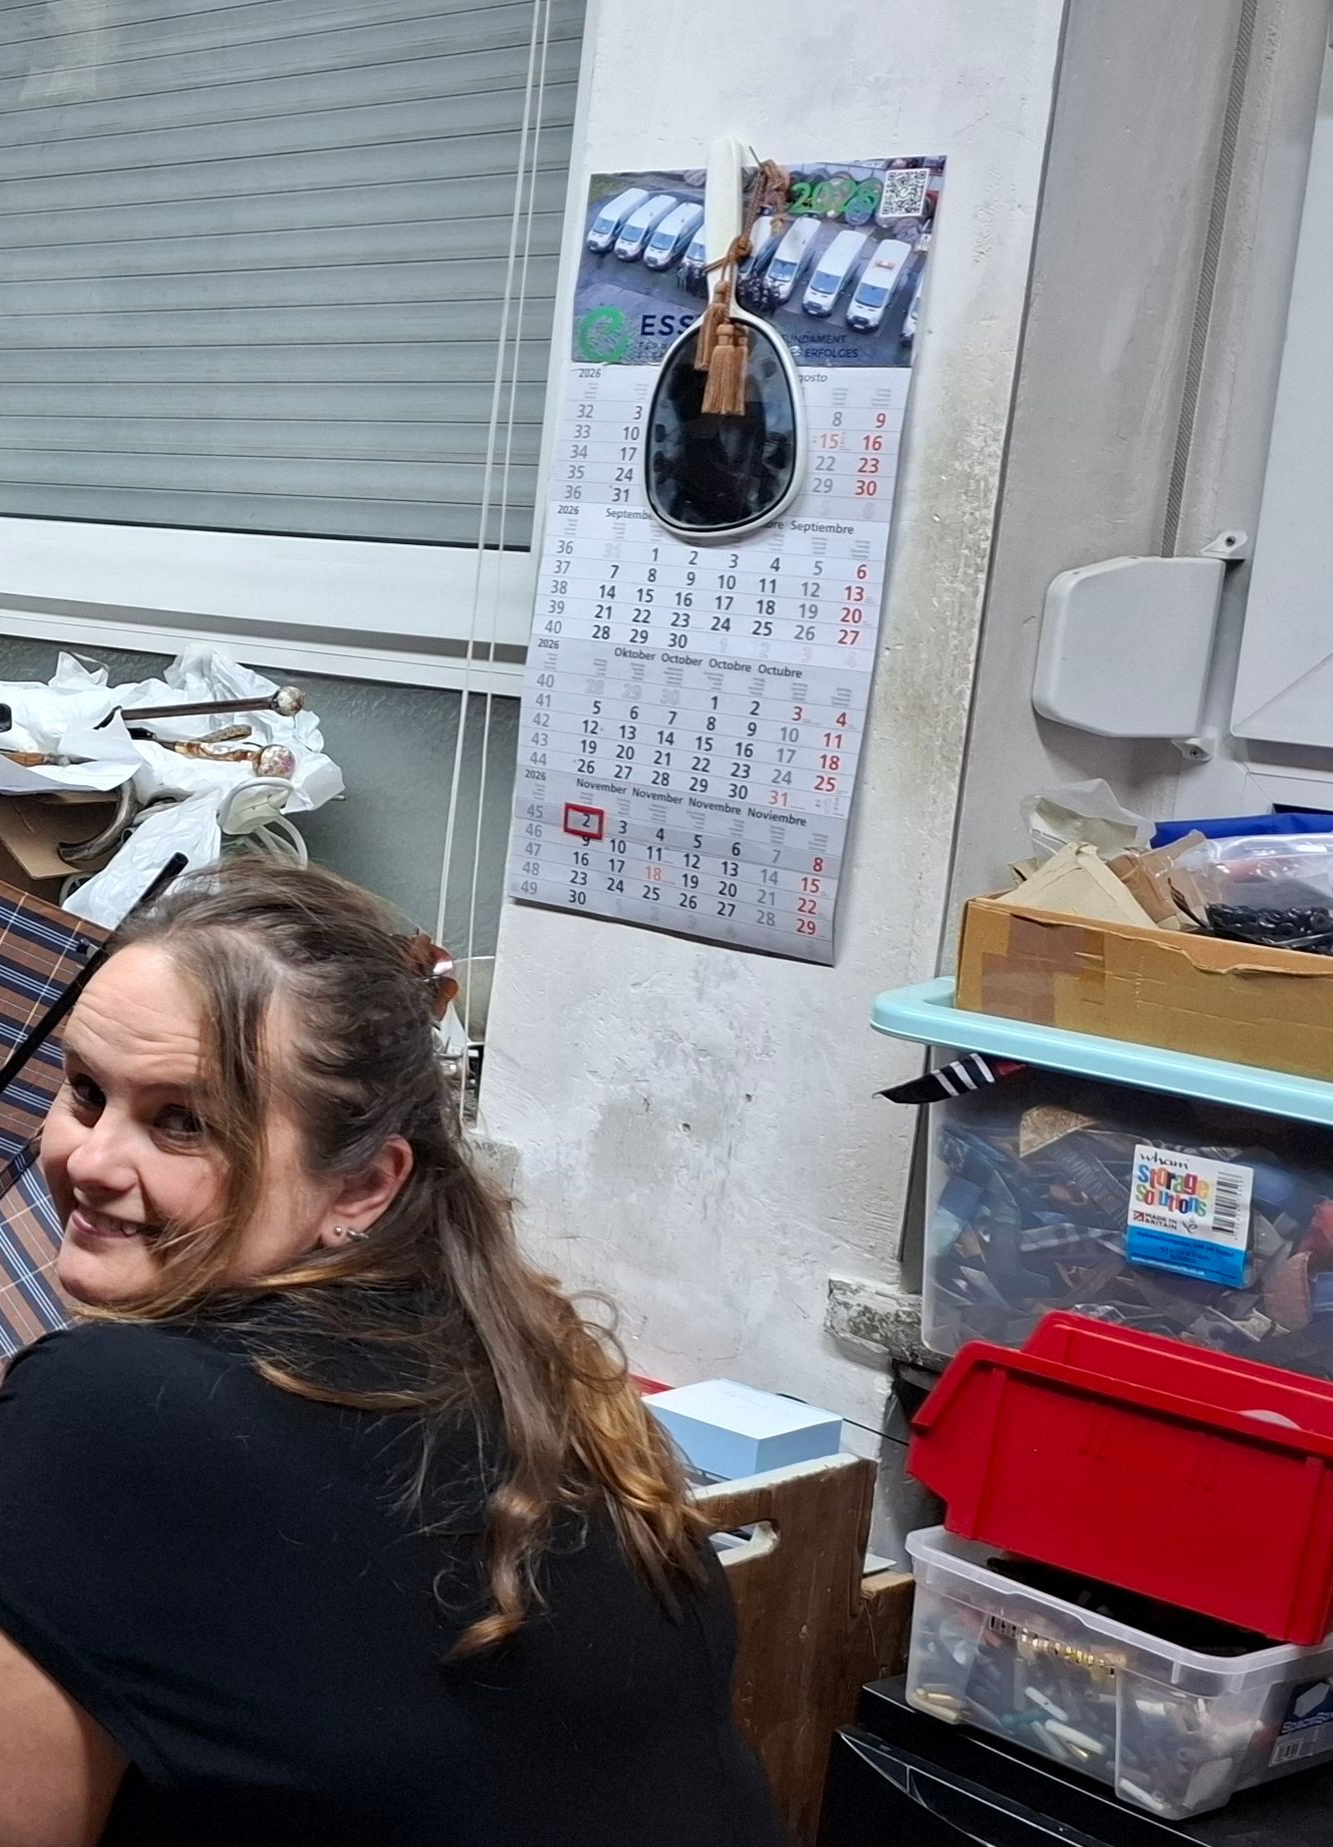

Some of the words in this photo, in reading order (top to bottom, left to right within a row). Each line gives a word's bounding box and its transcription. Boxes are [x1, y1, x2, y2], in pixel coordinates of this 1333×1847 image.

[805, 348, 859, 359] ERFOLGES
[579, 368, 601, 378] 2026
[799, 374, 827, 384] gosto
[577, 405, 593, 418] 32
[634, 406, 642, 419] 3
[833, 412, 842, 426] 8
[876, 413, 886, 428] 9
[574, 425, 590, 438] 33
[623, 427, 639, 440] 10
[820, 434, 839, 448] 15
[863, 435, 882, 450] 16
[570, 445, 587, 458] 34
[621, 448, 637, 461] 17
[815, 456, 835, 471] 22
[858, 458, 880, 473] 23
[565, 486, 581, 499] 36
[613, 488, 629, 502] 31
[567, 465, 585, 479] 35
[615, 468, 633, 482] 24
[812, 478, 833, 493] 29
[855, 481, 877, 495] 30
[557, 505, 579, 514] 2026
[606, 508, 654, 520] Septembe
[791, 521, 854, 534] Septiembre
[652, 548, 659, 561] 1
[689, 551, 698, 564] 2
[729, 554, 739, 568] 3
[770, 558, 780, 572] 4
[813, 561, 823, 575] 5
[857, 565, 867, 579] 6
[611, 565, 619, 578] 7
[648, 568, 657, 582] 8
[686, 572, 695, 585] 9
[718, 575, 736, 589] 10
[759, 579, 776, 593] 11
[801, 582, 820, 597] 12
[844, 586, 864, 601] 13
[599, 585, 615, 599] 14
[637, 588, 654, 602] 15
[675, 592, 692, 607] 16
[715, 596, 734, 610] 17
[757, 600, 775, 615] 18
[799, 604, 818, 619] 19
[841, 608, 862, 623] 20
[592, 625, 610, 639] 28
[629, 629, 648, 644] 29
[668, 633, 687, 648] 30
[595, 605, 612, 619] 21
[632, 609, 651, 623] 22
[671, 612, 690, 628] 23
[711, 617, 731, 632] 24
[752, 621, 773, 636] 25
[794, 625, 815, 641] 26
[838, 630, 859, 645] 27
[538, 639, 559, 649] 2026
[615, 648, 655, 661] Oktober
[661, 652, 702, 666] October
[709, 658, 752, 672] Octobre
[758, 664, 803, 678] Octubre
[593, 701, 601, 714] 5
[630, 706, 639, 719] 6
[668, 711, 677, 725] 7
[706, 717, 716, 731] 8
[747, 722, 757, 736] 9
[781, 727, 799, 742] 10
[824, 733, 842, 748] 11
[711, 696, 718, 710] 1
[750, 701, 760, 715] 2
[792, 706, 803, 721] 3
[836, 712, 847, 727] 4
[582, 720, 598, 734] 12
[619, 725, 636, 740] 13
[657, 731, 674, 745] 14
[696, 736, 713, 751] 15
[736, 742, 753, 757] 16
[778, 748, 796, 763] 17
[820, 754, 839, 770] 18
[577, 759, 595, 774] 26
[614, 765, 632, 779] 27
[652, 771, 670, 786] 28
[689, 777, 708, 792] 29
[728, 783, 748, 799] 30
[769, 790, 788, 806] 31
[581, 740, 597, 754] 19
[616, 745, 634, 760] 20
[653, 751, 671, 766] 21
[691, 757, 710, 772] 22
[731, 763, 751, 778] 23
[771, 769, 792, 785] 24
[814, 776, 837, 792] 25
[525, 769, 546, 780] 2026
[577, 779, 627, 794] November
[633, 788, 683, 804] November
[689, 798, 741, 815] Novembre
[748, 808, 807, 826] Noviembre
[582, 814, 591, 827] 2
[619, 821, 627, 834] 3
[656, 828, 665, 841] 4
[694, 834, 703, 848] 5
[732, 842, 741, 856] 6
[772, 850, 781, 863] 7
[813, 858, 823, 872] 8
[610, 839, 626, 853] 10
[647, 846, 662, 861] 11
[684, 854, 700, 869] 12
[722, 861, 739, 876] 13
[761, 869, 778, 885] 14
[801, 877, 820, 893] 15
[569, 890, 586, 905] 30
[573, 852, 589, 866] 16
[609, 859, 625, 873] 17
[645, 866, 661, 881] 18
[683, 874, 699, 888] 19
[718, 882, 737, 897] 20
[757, 890, 775, 906] 21
[798, 898, 816, 914] 22
[571, 871, 588, 885] 23
[607, 878, 624, 893] 24
[643, 885, 660, 900] 25
[679, 894, 697, 909] 26
[717, 902, 736, 917] 27
[757, 910, 775, 926] 28
[797, 919, 816, 935] 29
[1137, 1164, 1209, 1200] Storage
[1145, 1213, 1167, 1222] MADE
[1168, 1216, 1178, 1224] IN
[1145, 1218, 1178, 1230] BRITAIN
